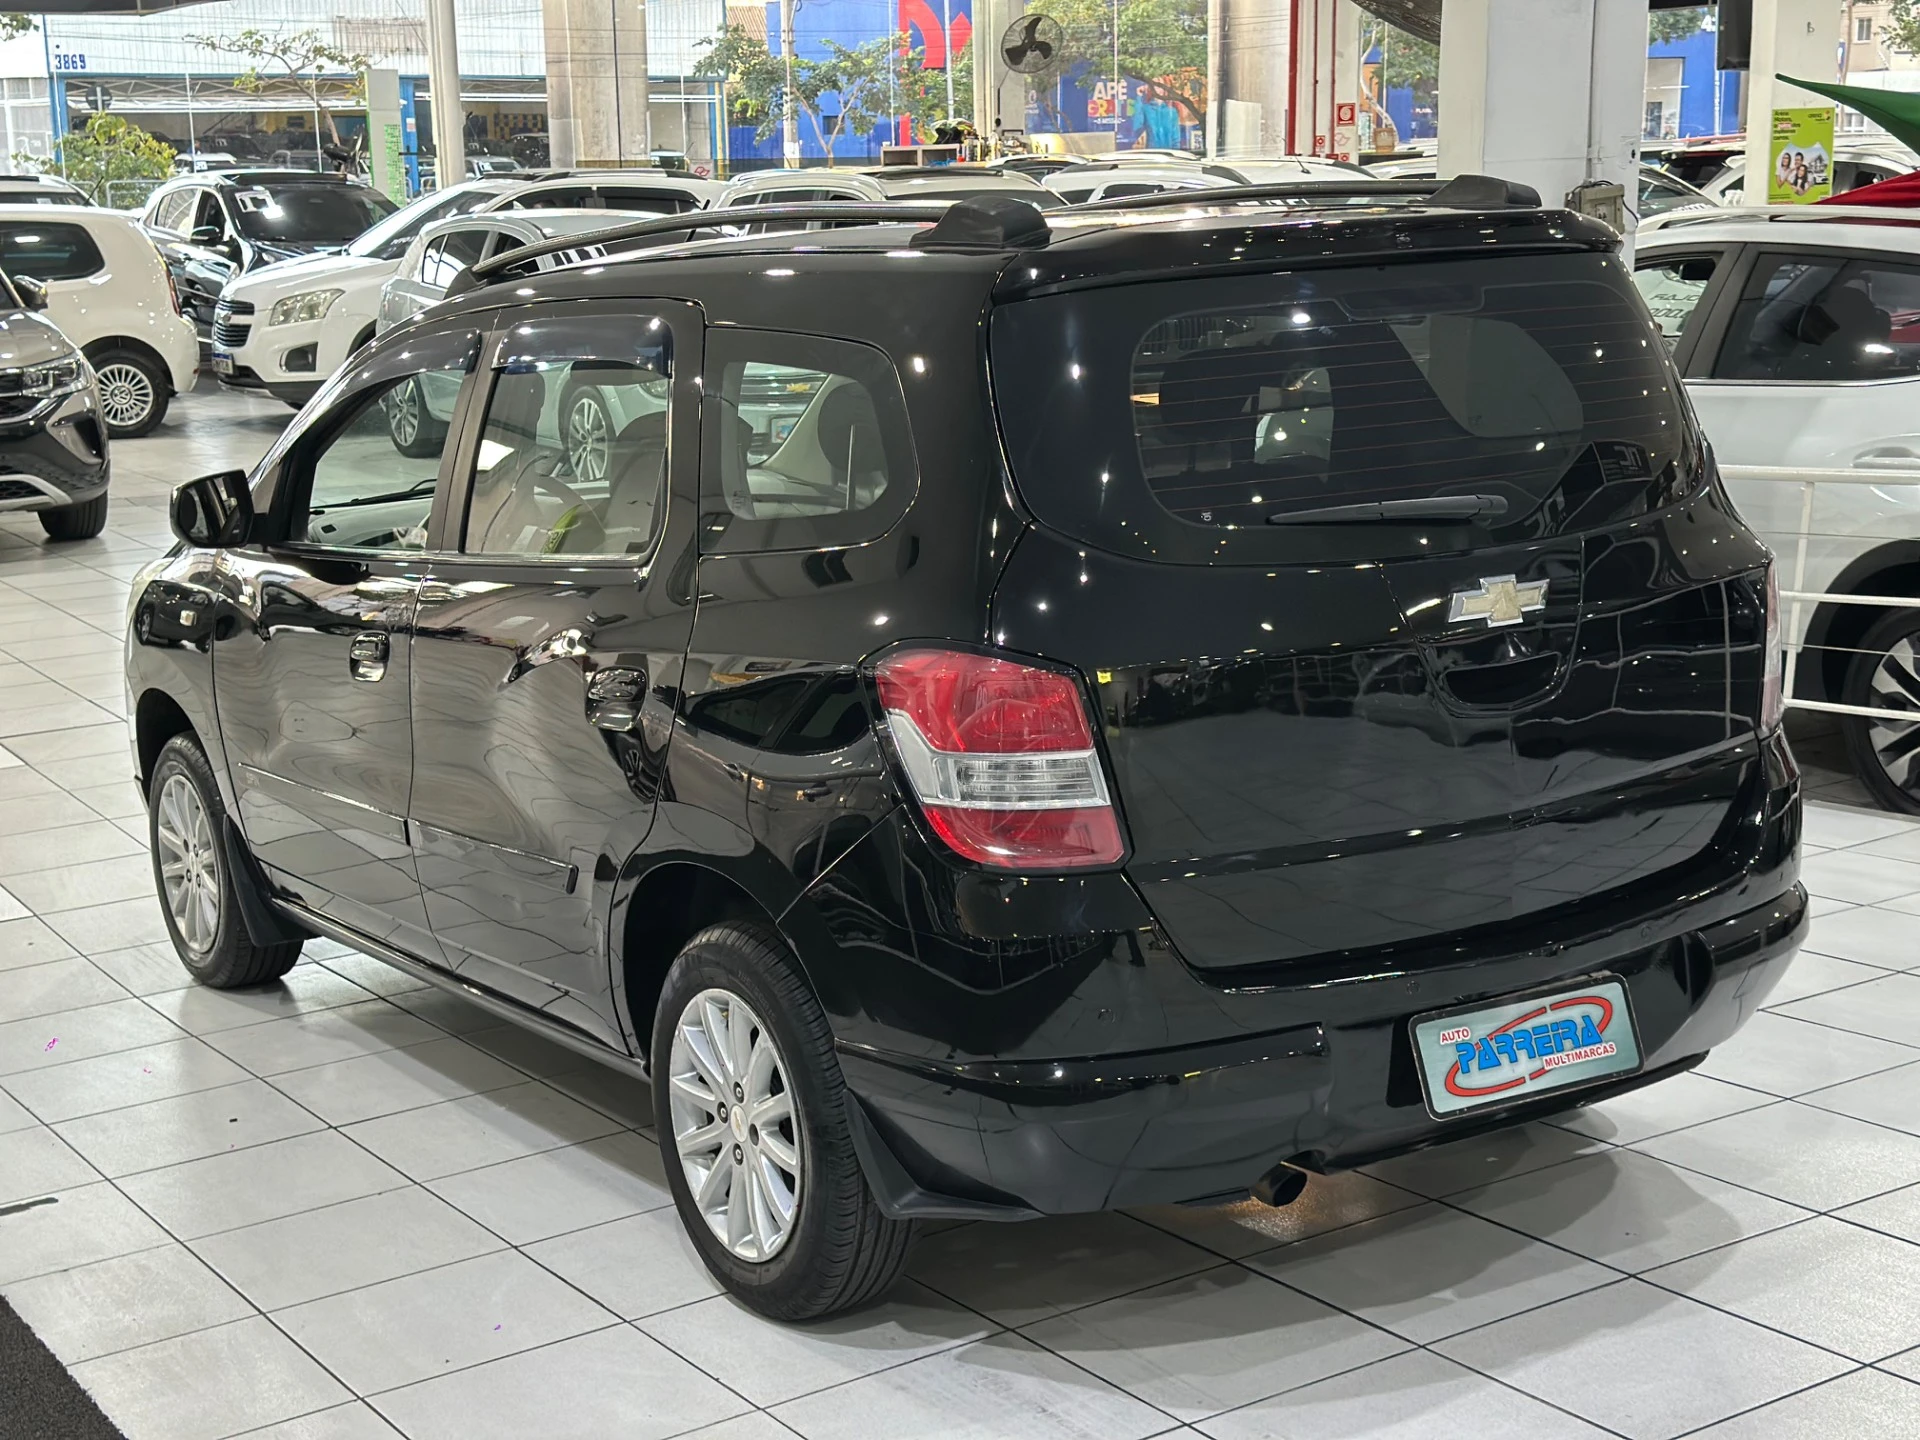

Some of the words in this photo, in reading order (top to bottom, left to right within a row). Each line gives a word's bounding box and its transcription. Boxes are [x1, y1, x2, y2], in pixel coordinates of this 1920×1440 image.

[55, 54, 86, 70] 3869
[1092, 79, 1128, 101] APÊ
[1441, 1028, 1471, 1044] AUTO
[1455, 1015, 1603, 1074] PARREIRA
[1544, 1044, 1616, 1068] MULTIMARCAS
